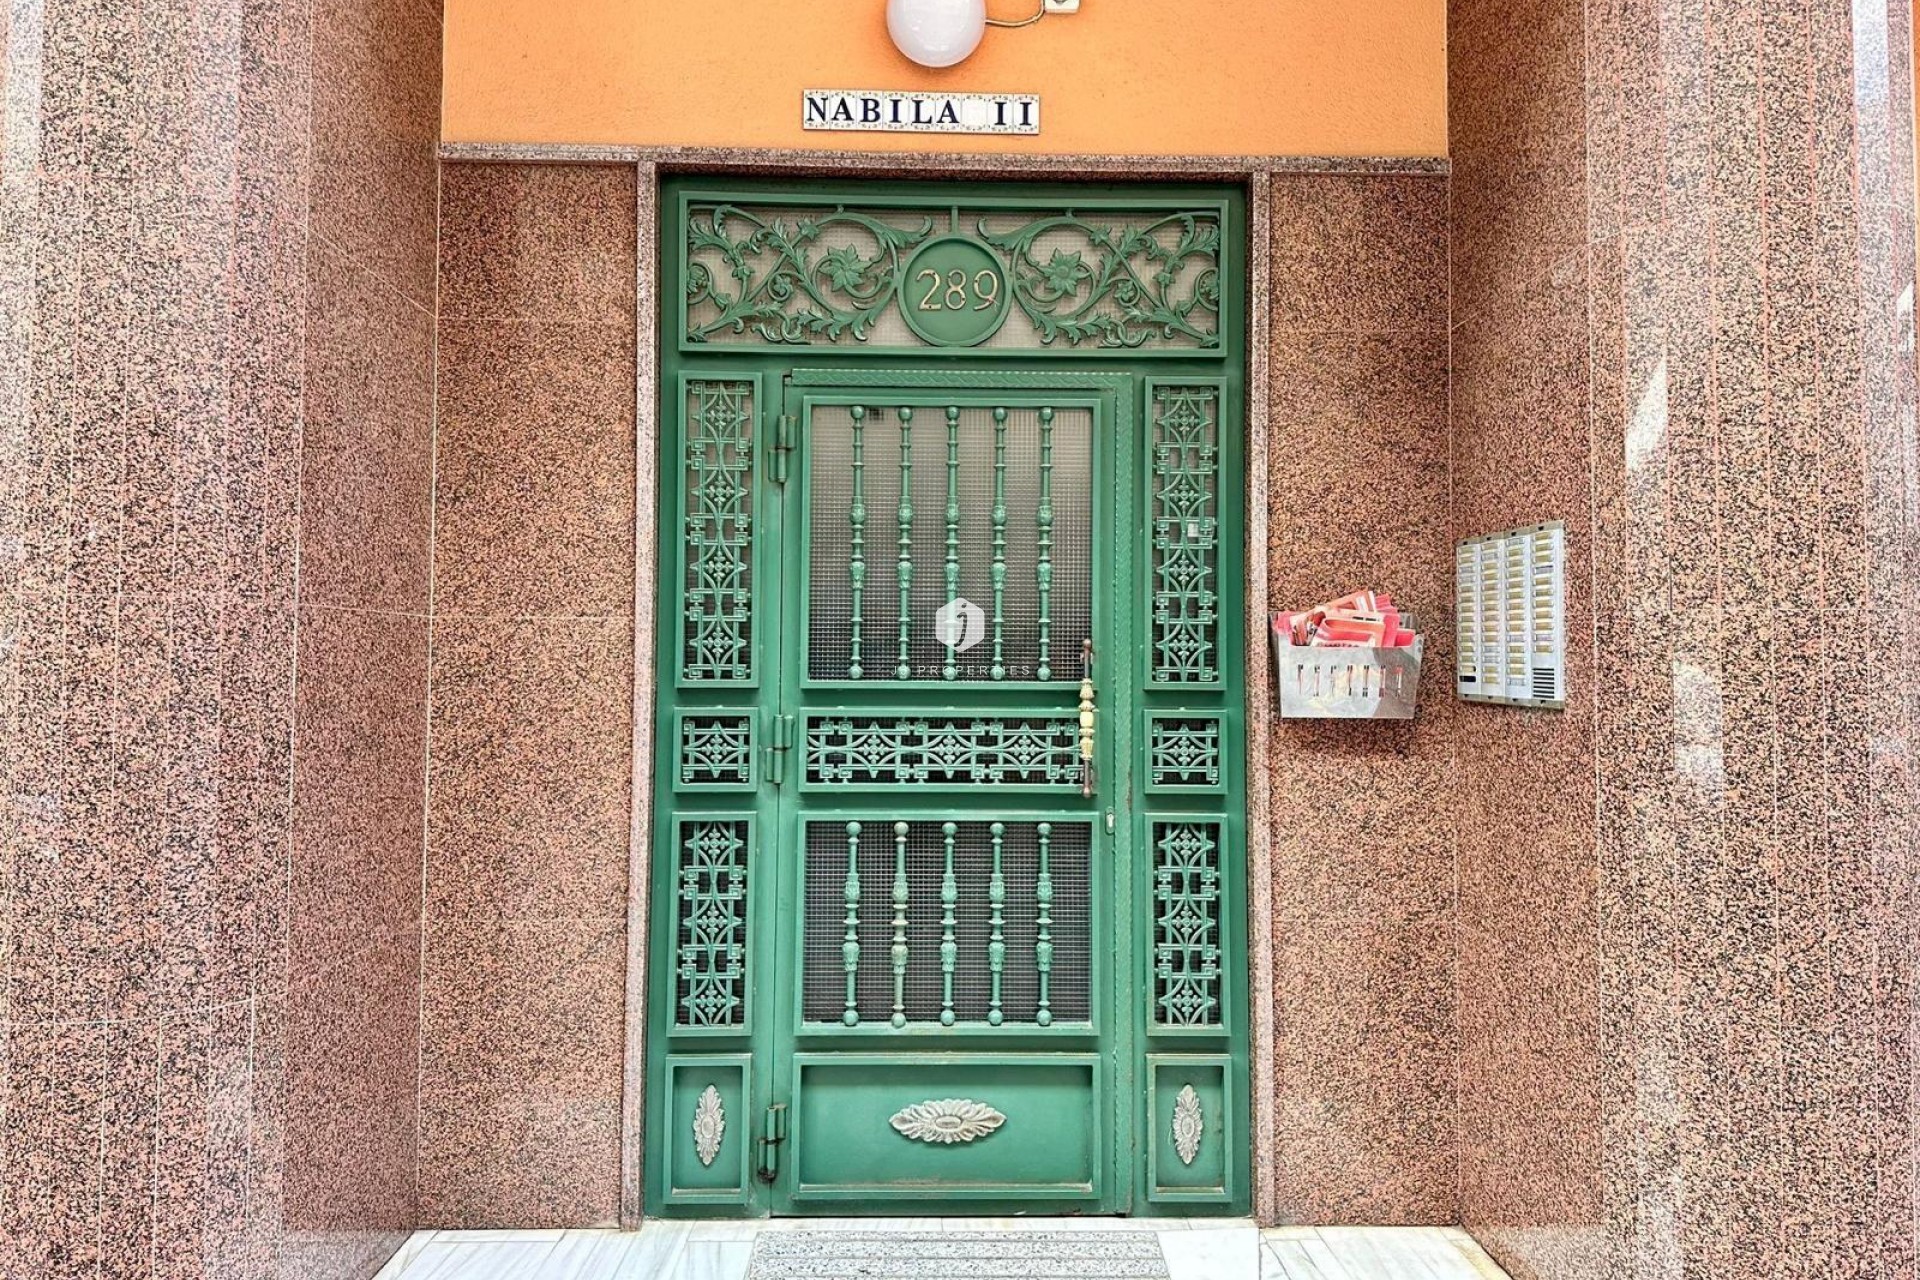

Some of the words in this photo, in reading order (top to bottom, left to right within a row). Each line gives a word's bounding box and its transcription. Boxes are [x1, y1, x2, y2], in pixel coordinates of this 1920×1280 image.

[806, 97, 960, 124] NABILA
[994, 101, 1033, 126] II
[916, 269, 998, 311] 289
